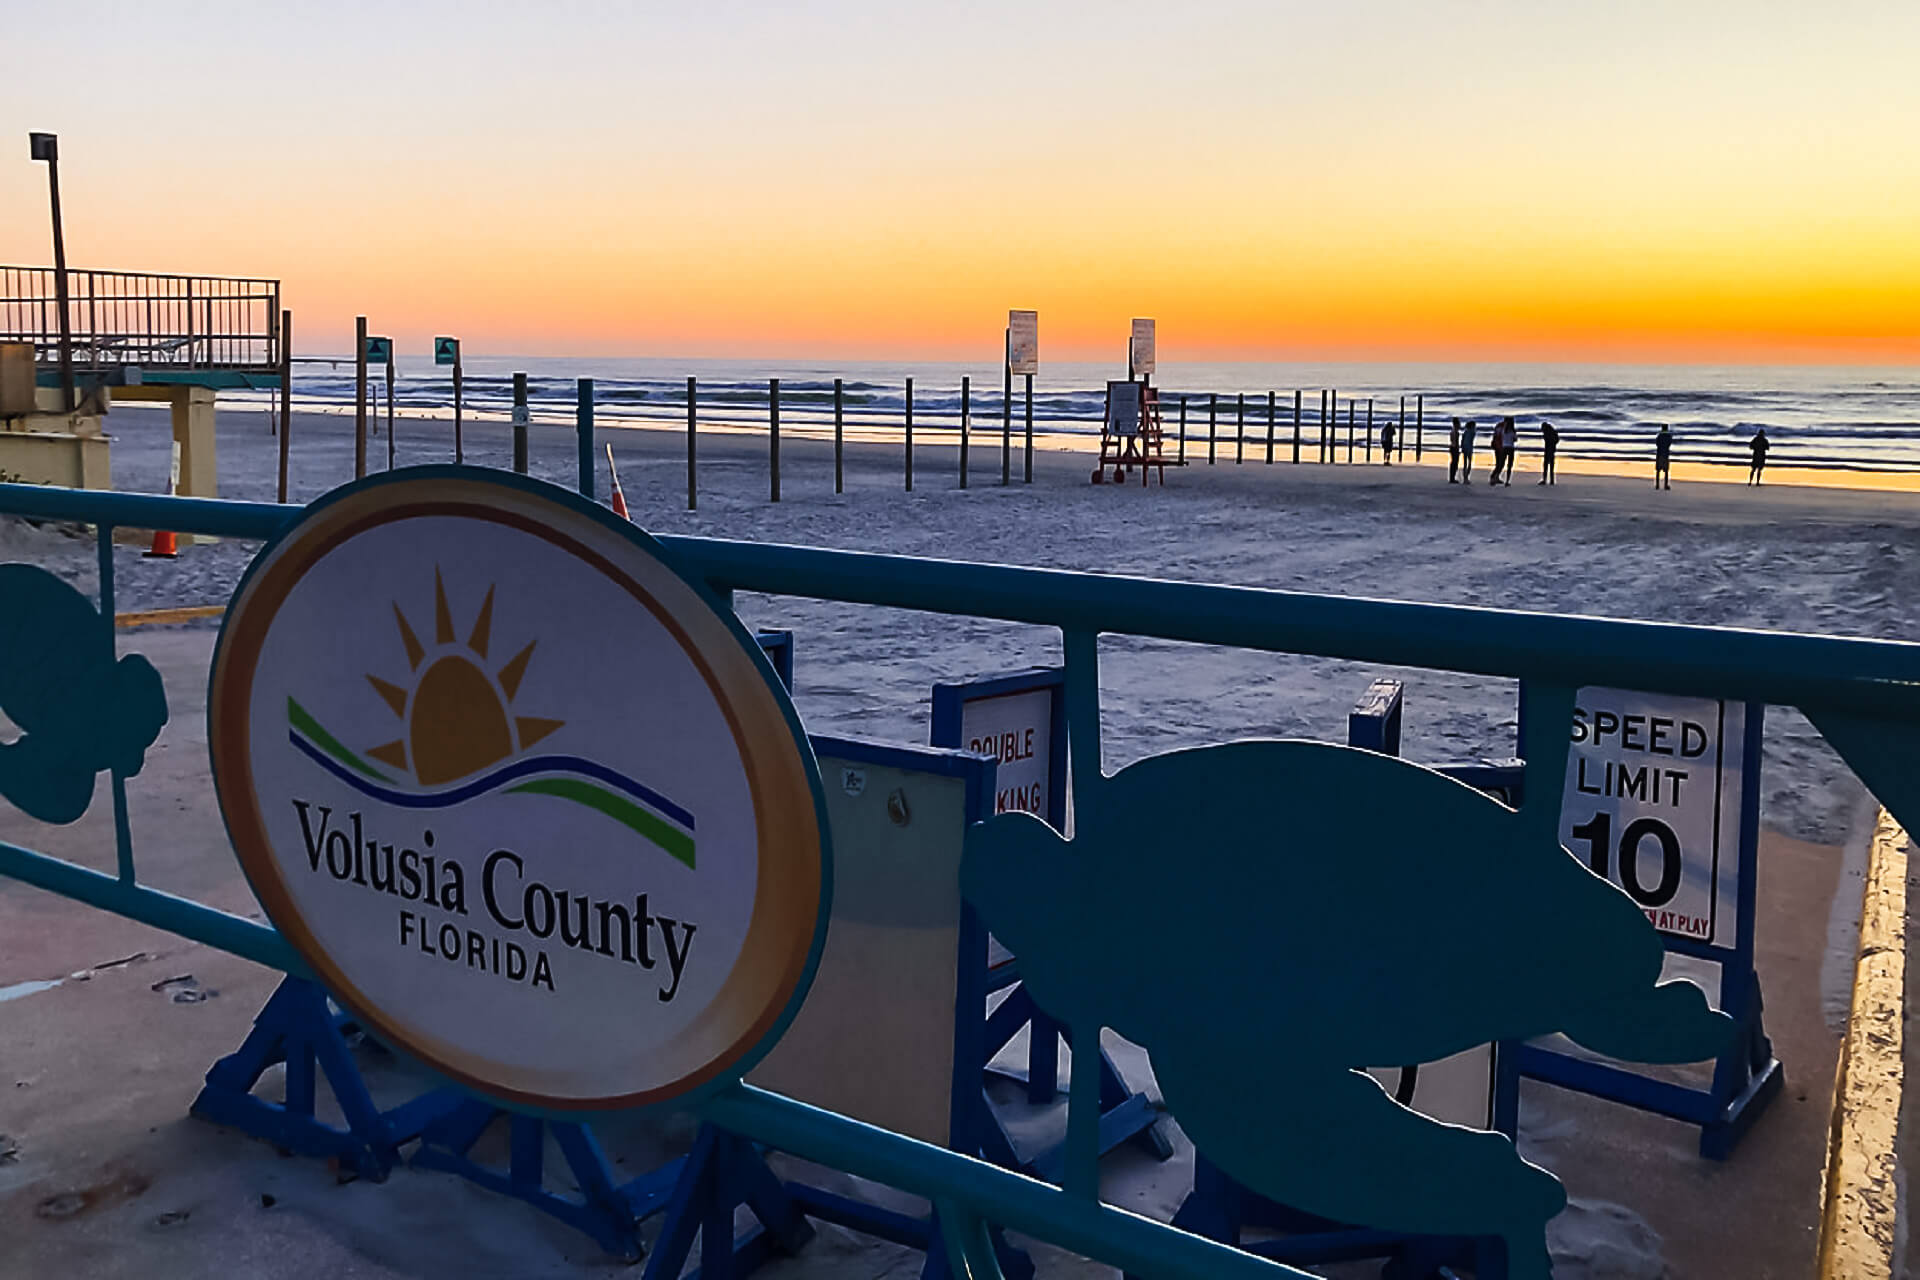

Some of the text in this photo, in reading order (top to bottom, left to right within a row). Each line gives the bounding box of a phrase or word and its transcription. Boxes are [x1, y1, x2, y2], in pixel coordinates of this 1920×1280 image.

[1571, 708, 1708, 758] SPEED
[997, 781, 1041, 814] KING
[1578, 758, 1689, 807] LIMIT
[1572, 812, 1682, 908] 10
[292, 799, 697, 1002] Volusia County
[1660, 911, 1676, 929] AT
[1678, 914, 1709, 937] PLAY
[400, 910, 556, 992] FLORIDA
